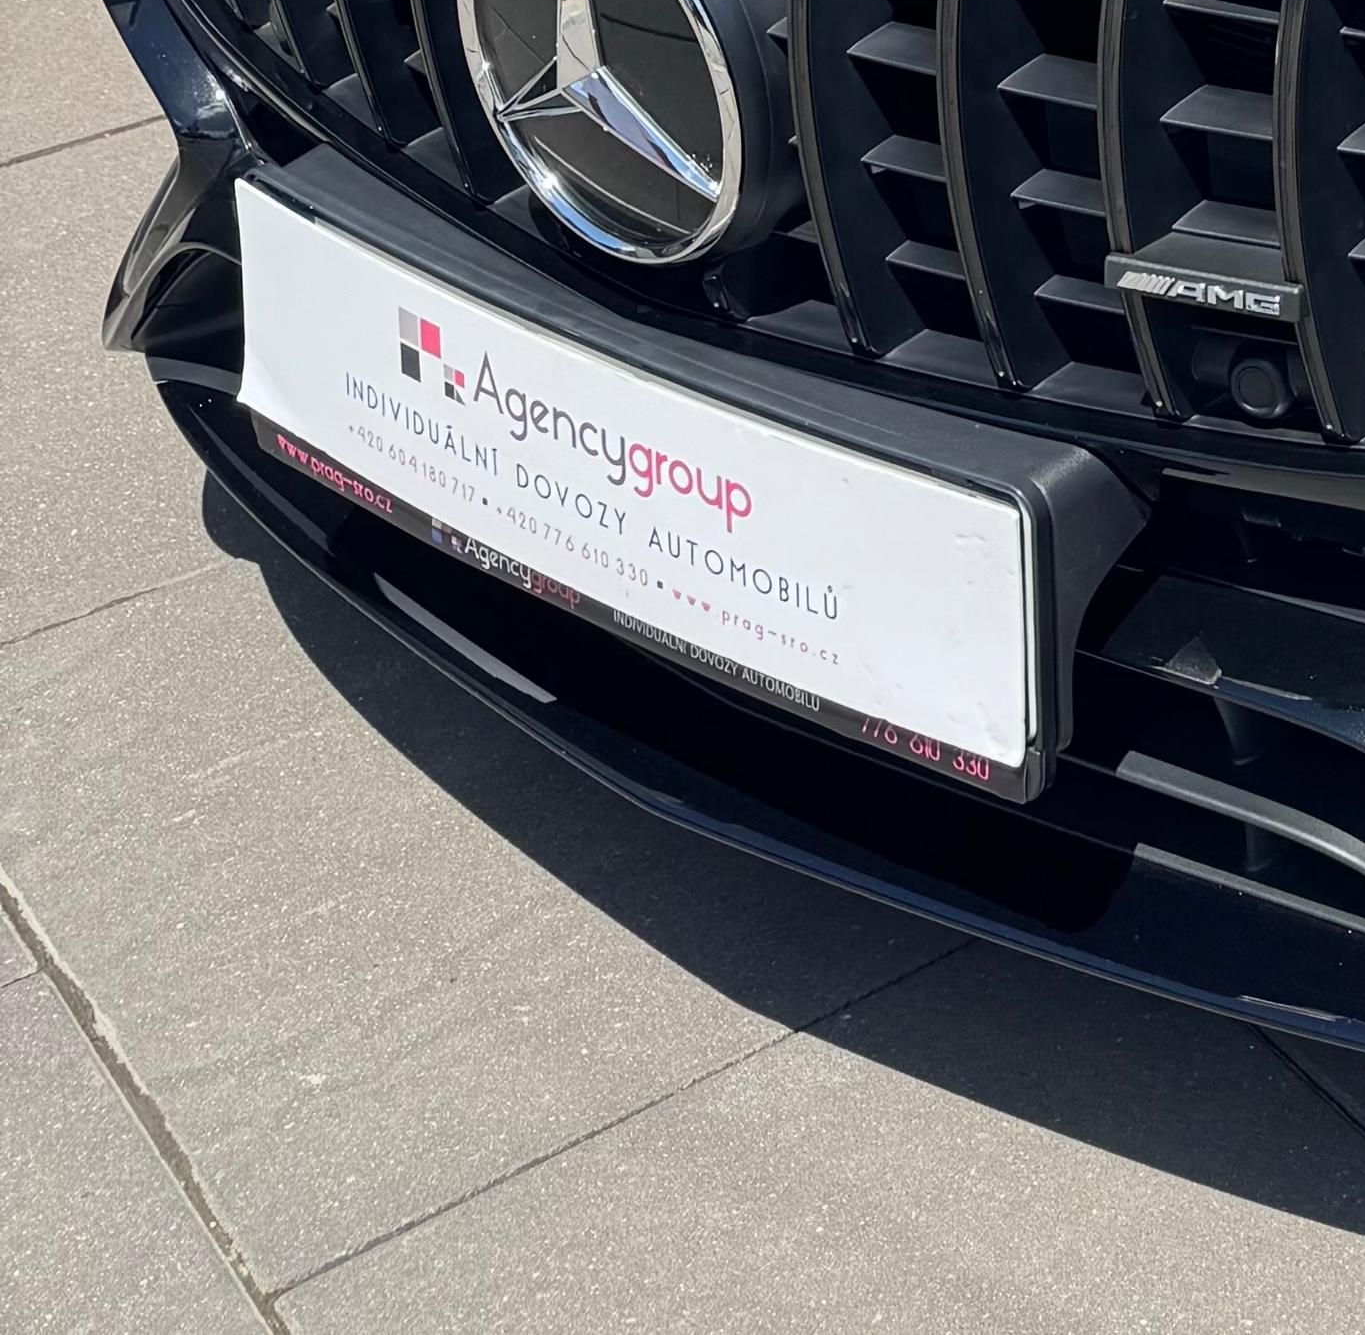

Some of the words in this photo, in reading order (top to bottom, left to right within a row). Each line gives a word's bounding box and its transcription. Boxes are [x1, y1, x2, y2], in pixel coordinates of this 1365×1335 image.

[1166, 279, 1281, 317] AMG
[473, 350, 752, 533] Agencygroup
[348, 424, 384, 453] +420
[388, 443, 418, 474] 604
[422, 462, 447, 491] 180
[451, 476, 476, 503] 717
[496, 506, 537, 535] +420
[543, 522, 575, 553] 776
[581, 542, 609, 570] 610
[616, 557, 648, 587] 330
[516, 463, 626, 535] DOVOZY
[648, 525, 838, 620] AUTOMOBILŮ
[464, 537, 581, 610] Agencygroup
[690, 644, 740, 677] DOVOZY
